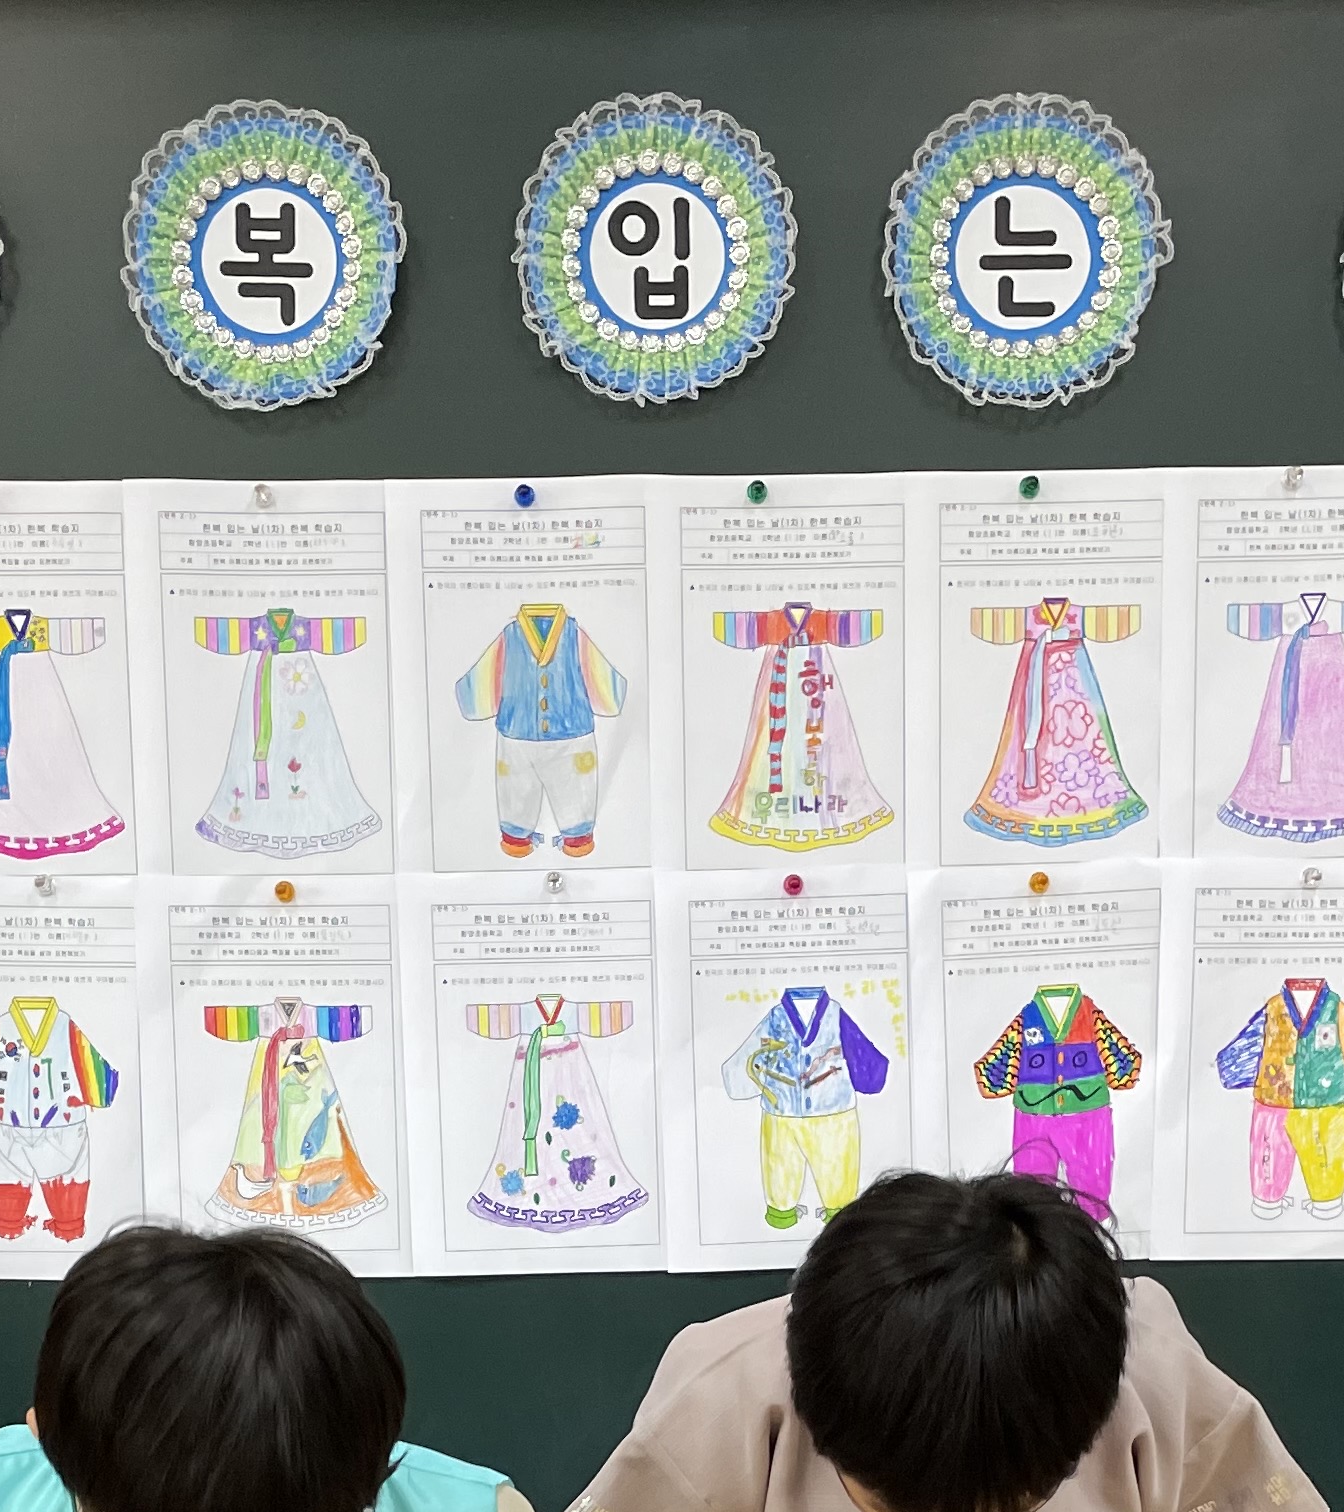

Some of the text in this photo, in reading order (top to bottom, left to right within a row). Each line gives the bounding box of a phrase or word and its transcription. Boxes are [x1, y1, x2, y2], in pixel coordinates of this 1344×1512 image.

[220, 201, 313, 327] 복
[606, 196, 691, 320] 입
[979, 196, 1073, 319] 는
[752, 791, 849, 824] 우리나라
